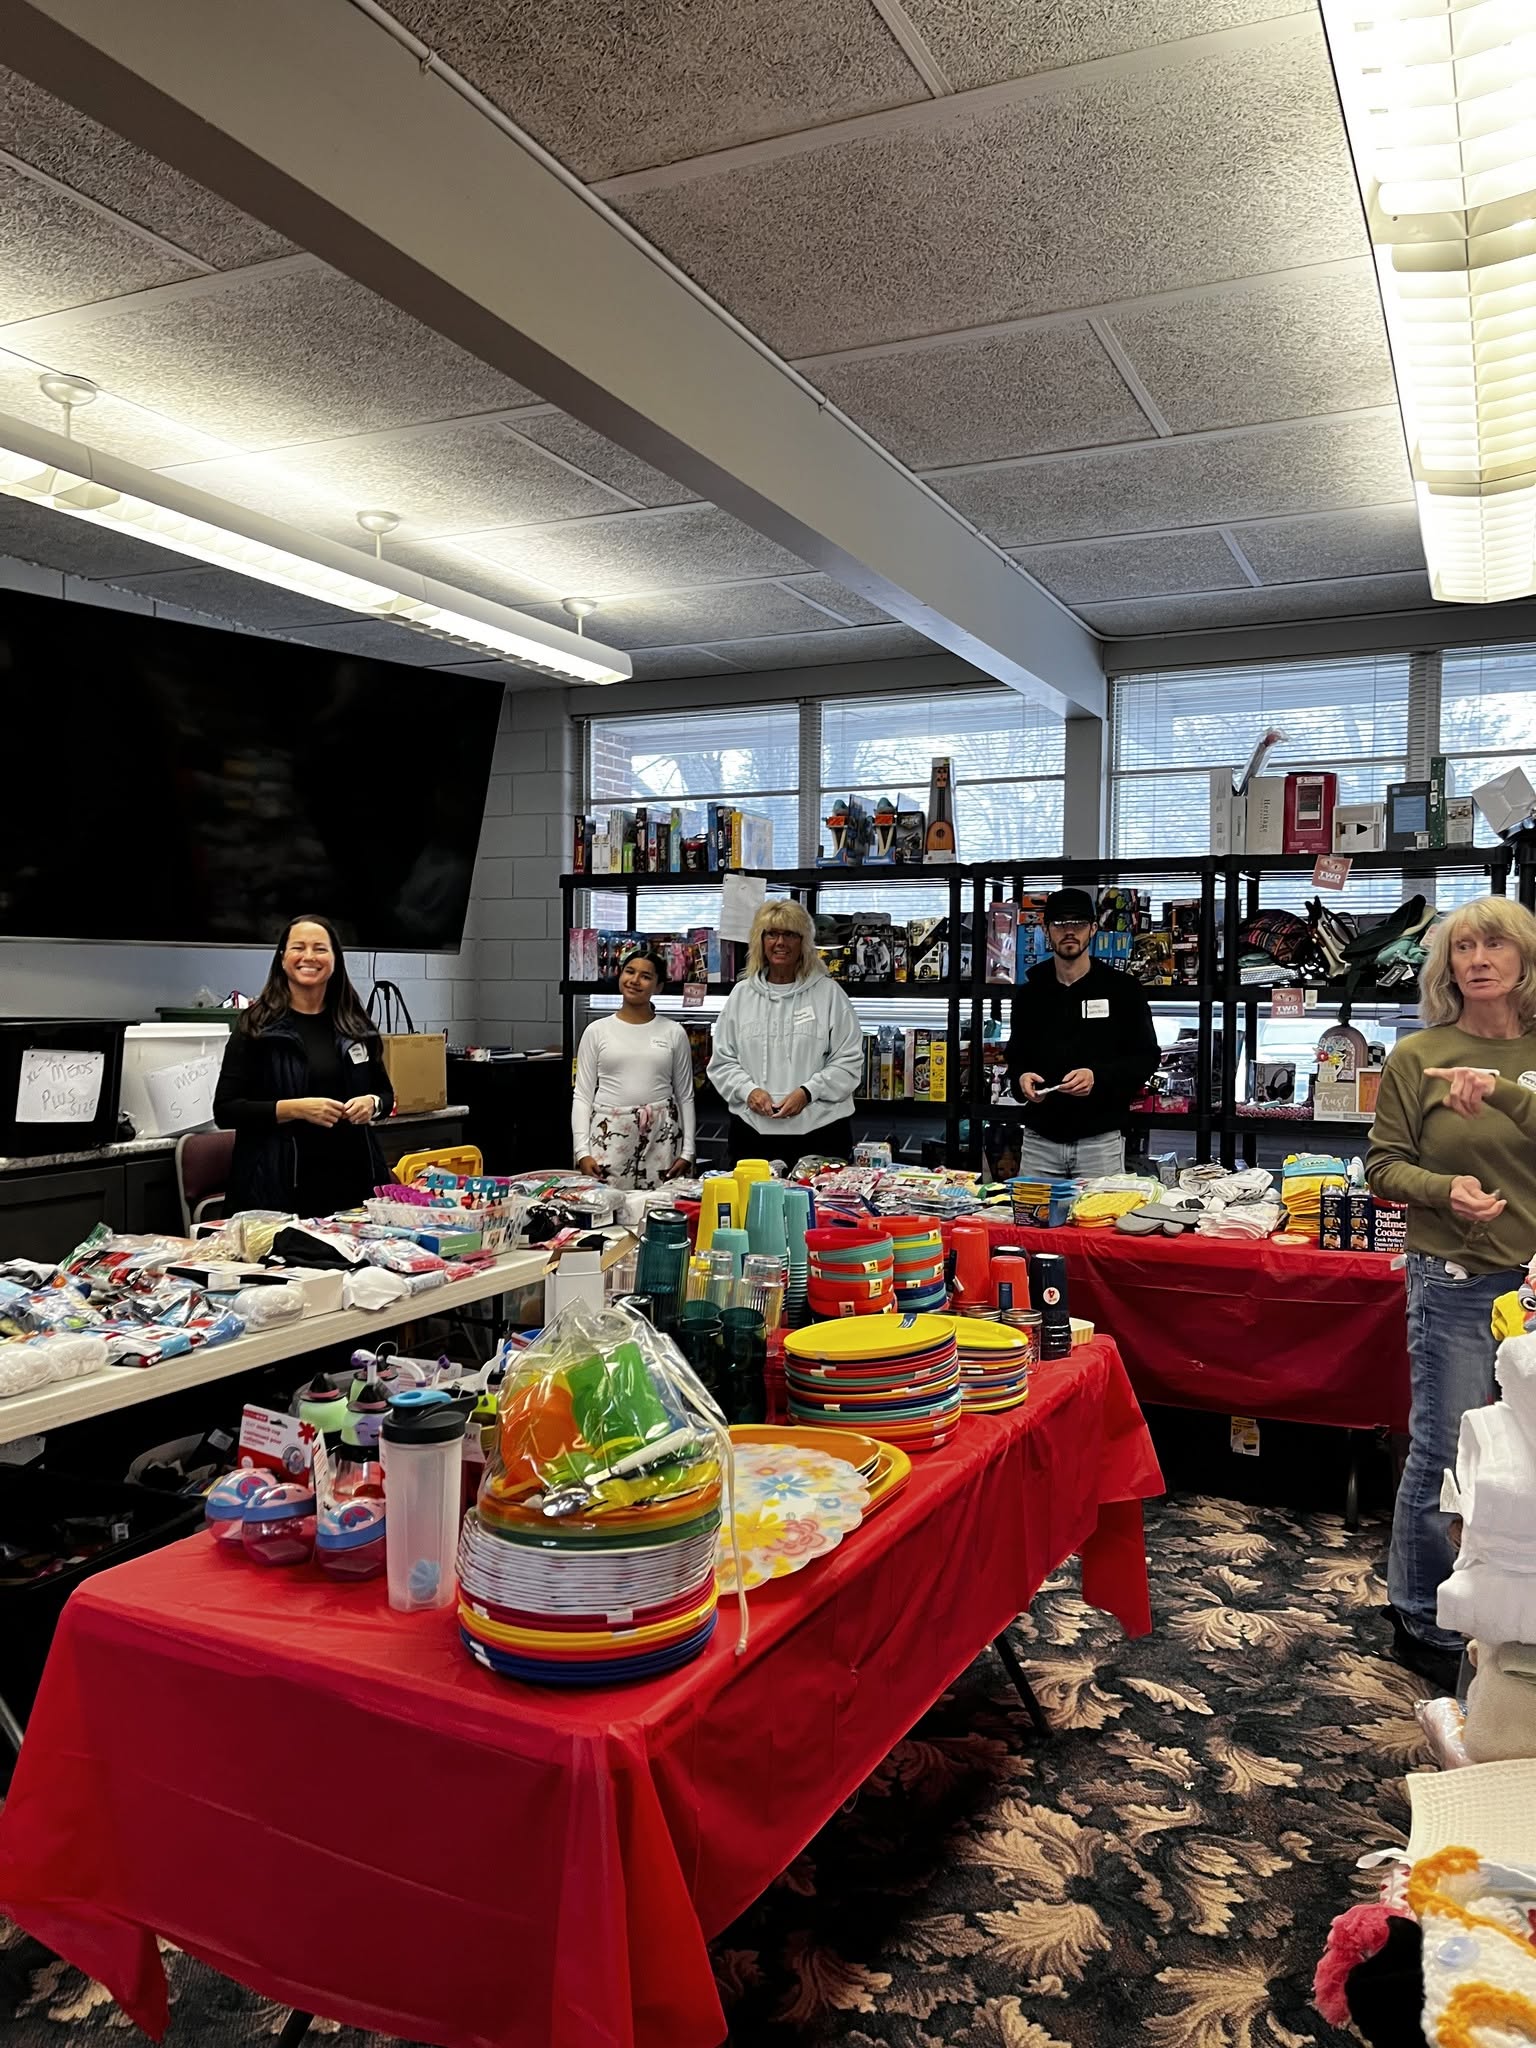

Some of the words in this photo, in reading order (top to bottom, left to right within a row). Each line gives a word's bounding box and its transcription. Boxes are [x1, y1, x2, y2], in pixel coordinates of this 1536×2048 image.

[1319, 870, 1341, 880] TWO
[41, 1088, 77, 1112] PLUS
[1375, 1209, 1401, 1221] Rapid
[1375, 1218, 1407, 1229] Oatmea
[1375, 1227, 1407, 1238] Cooker
